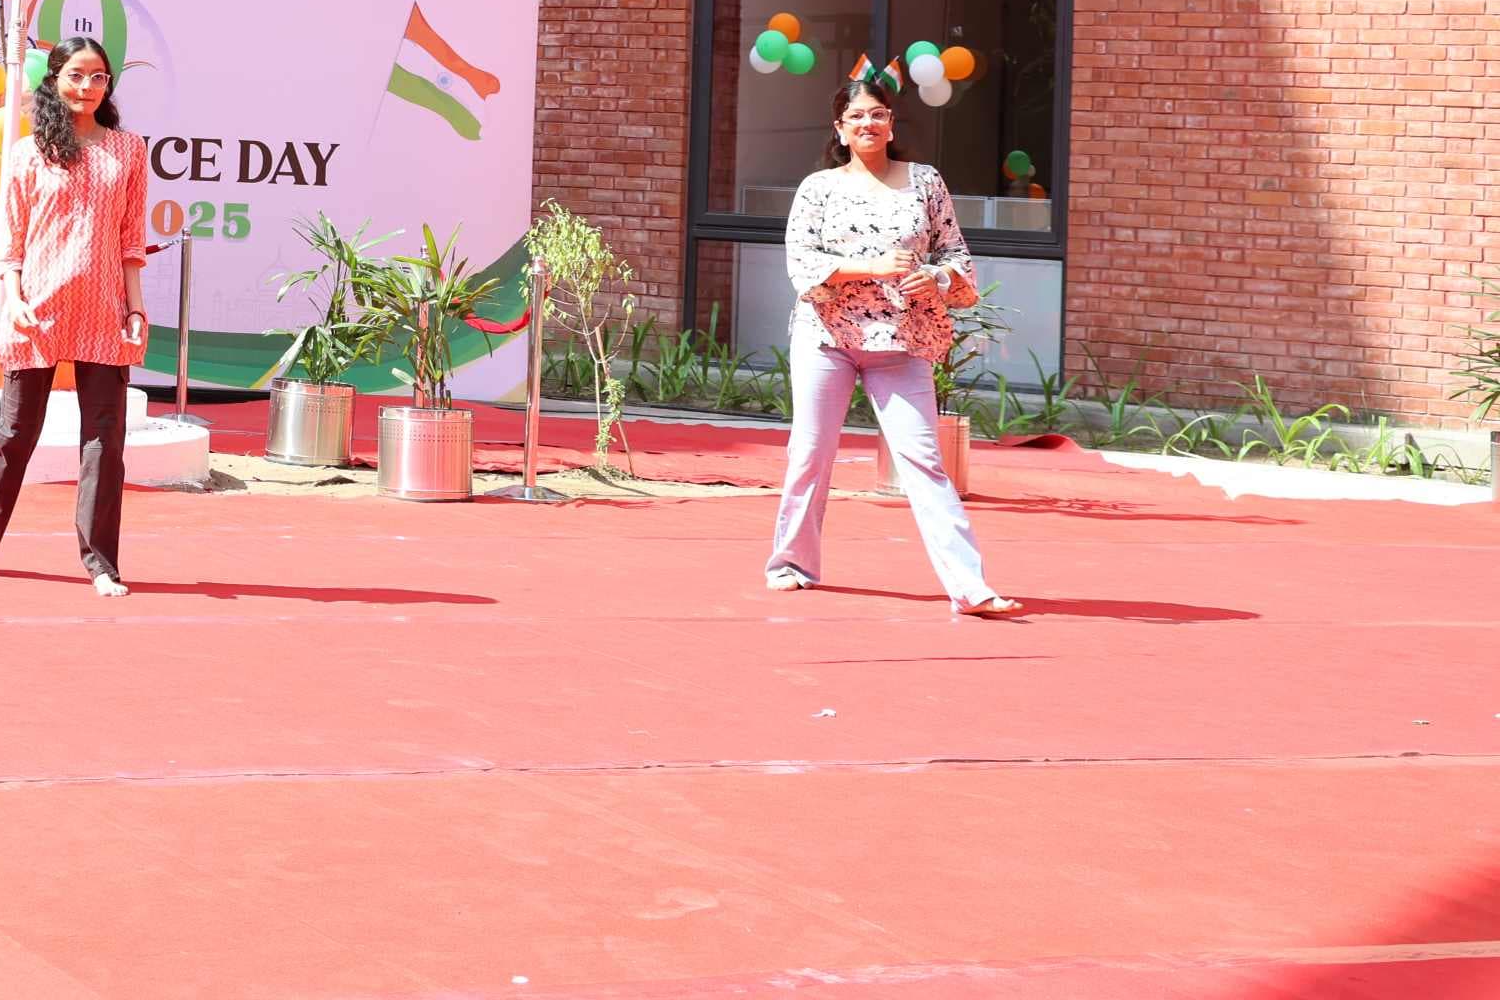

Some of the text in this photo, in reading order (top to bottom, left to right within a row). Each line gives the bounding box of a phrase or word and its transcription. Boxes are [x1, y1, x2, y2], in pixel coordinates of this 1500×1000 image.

[74, 17, 93, 33] th
[236, 139, 341, 187] DAY
[150, 199, 252, 240] 025
